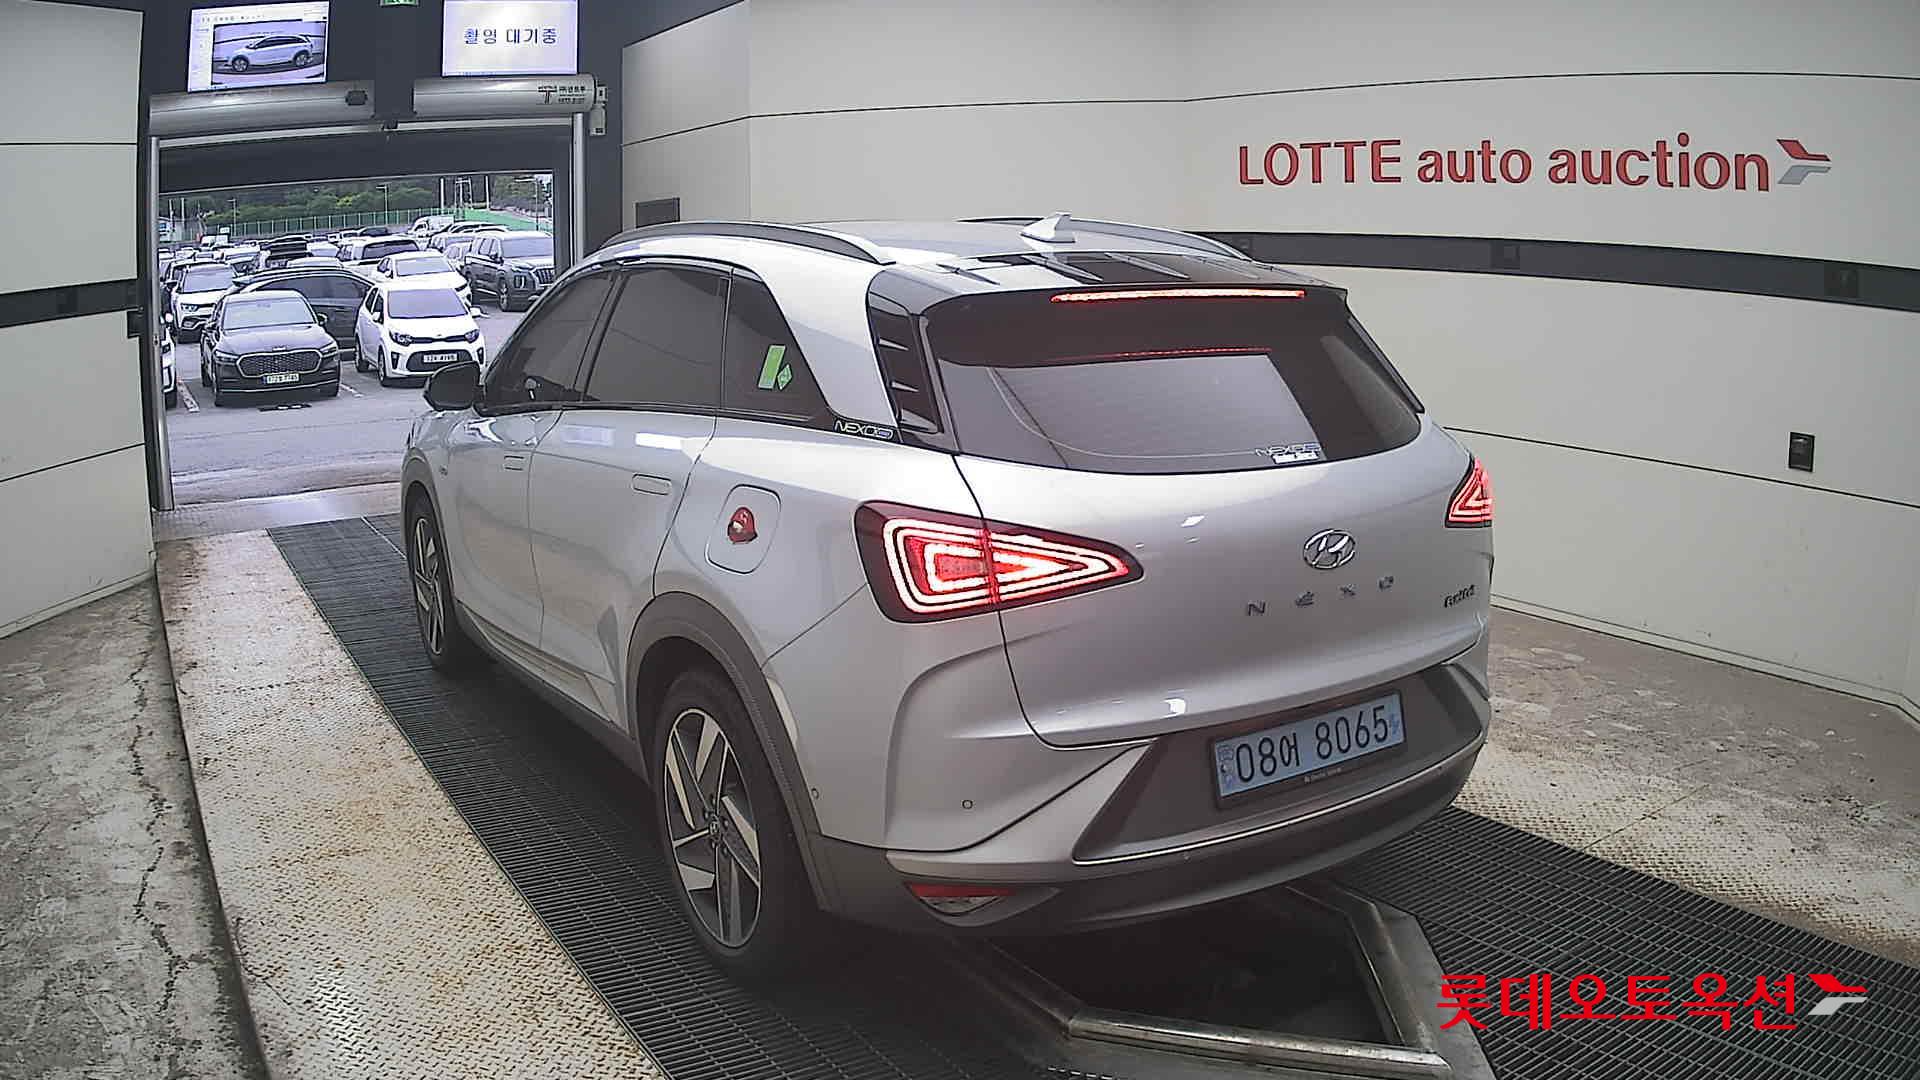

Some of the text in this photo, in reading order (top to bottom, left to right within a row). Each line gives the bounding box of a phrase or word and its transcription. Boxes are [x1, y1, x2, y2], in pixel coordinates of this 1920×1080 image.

[506, 28, 557, 44] 대기중
[1239, 132, 1769, 192] LOTTE auto auction
[1236, 705, 1389, 783] 08어 8065
